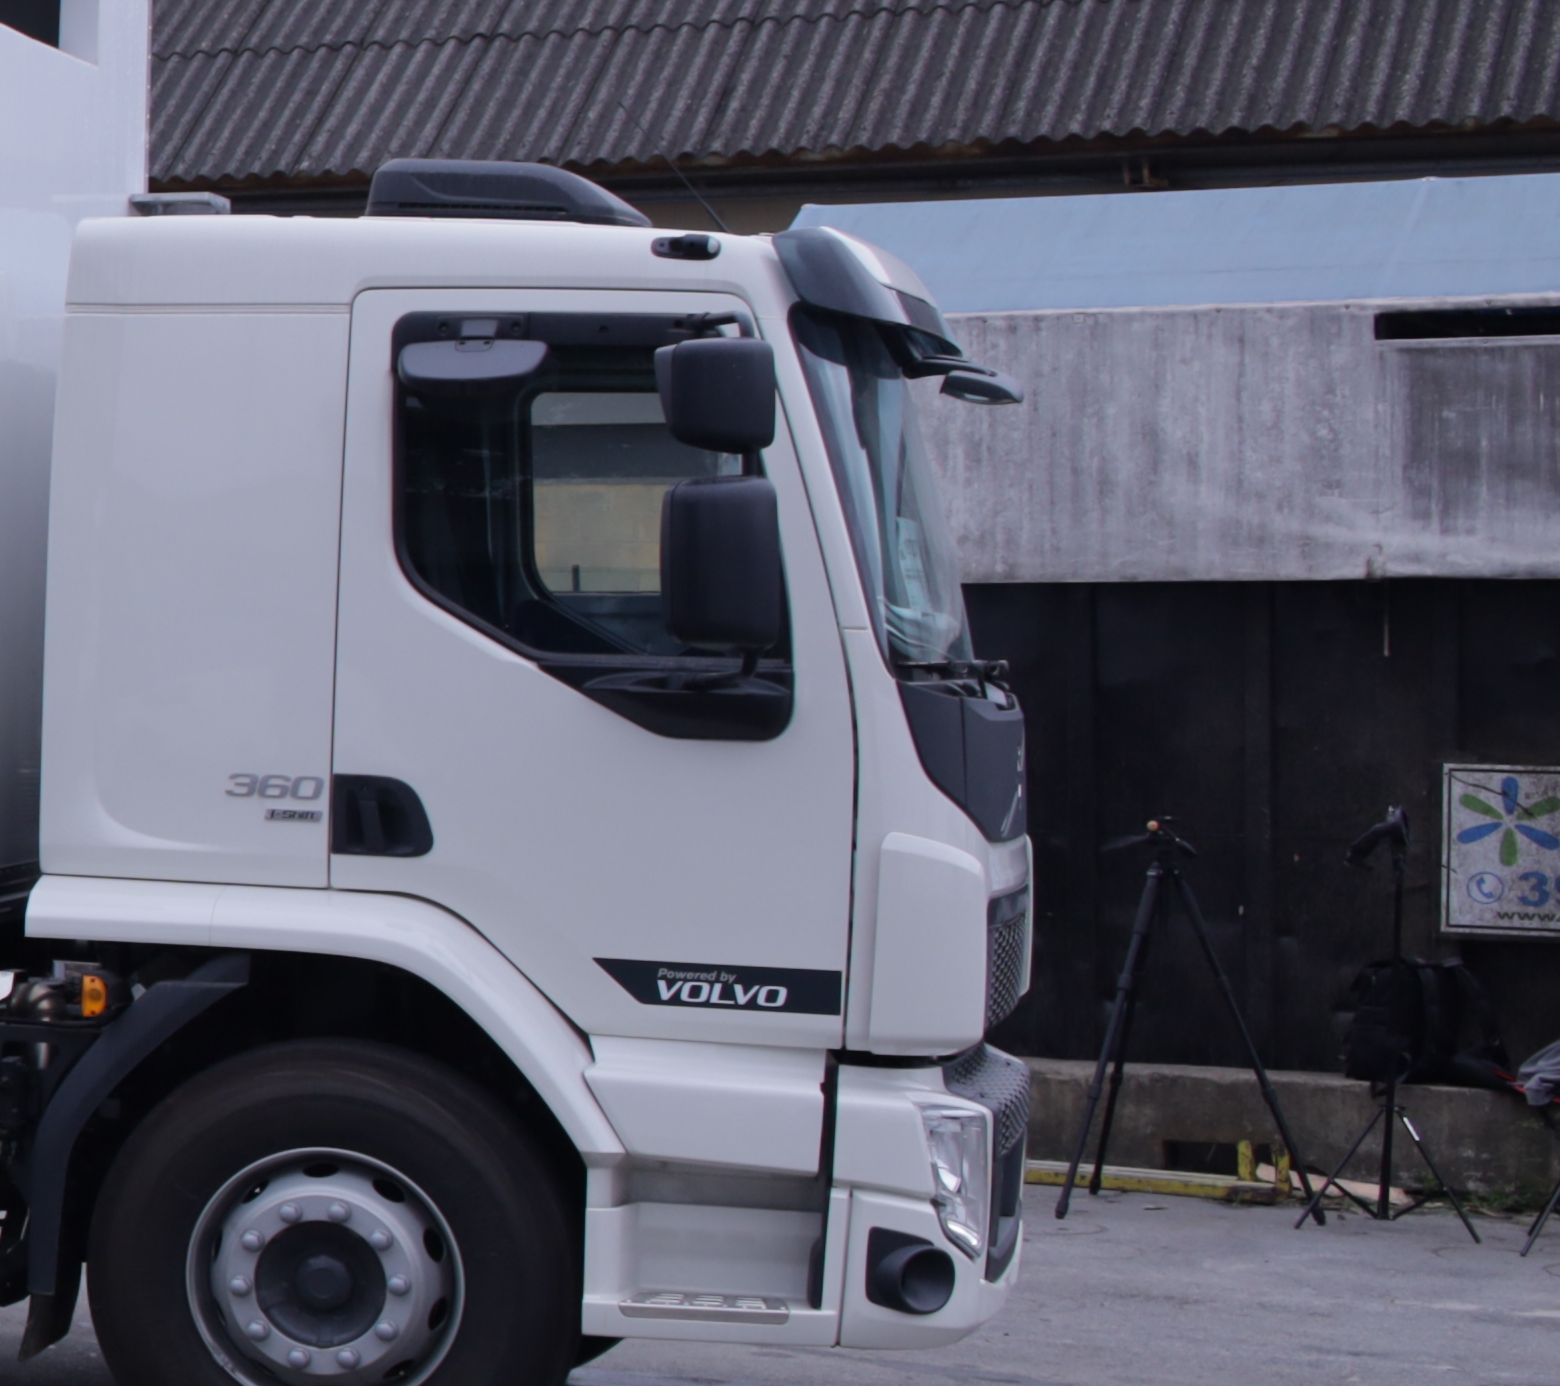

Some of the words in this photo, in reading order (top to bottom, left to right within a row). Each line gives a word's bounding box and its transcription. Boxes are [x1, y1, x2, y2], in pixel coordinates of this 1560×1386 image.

[224, 772, 325, 801] 360
[656, 967, 717, 982] Powered
[719, 970, 737, 985] by
[656, 978, 789, 1008] VOLVO
